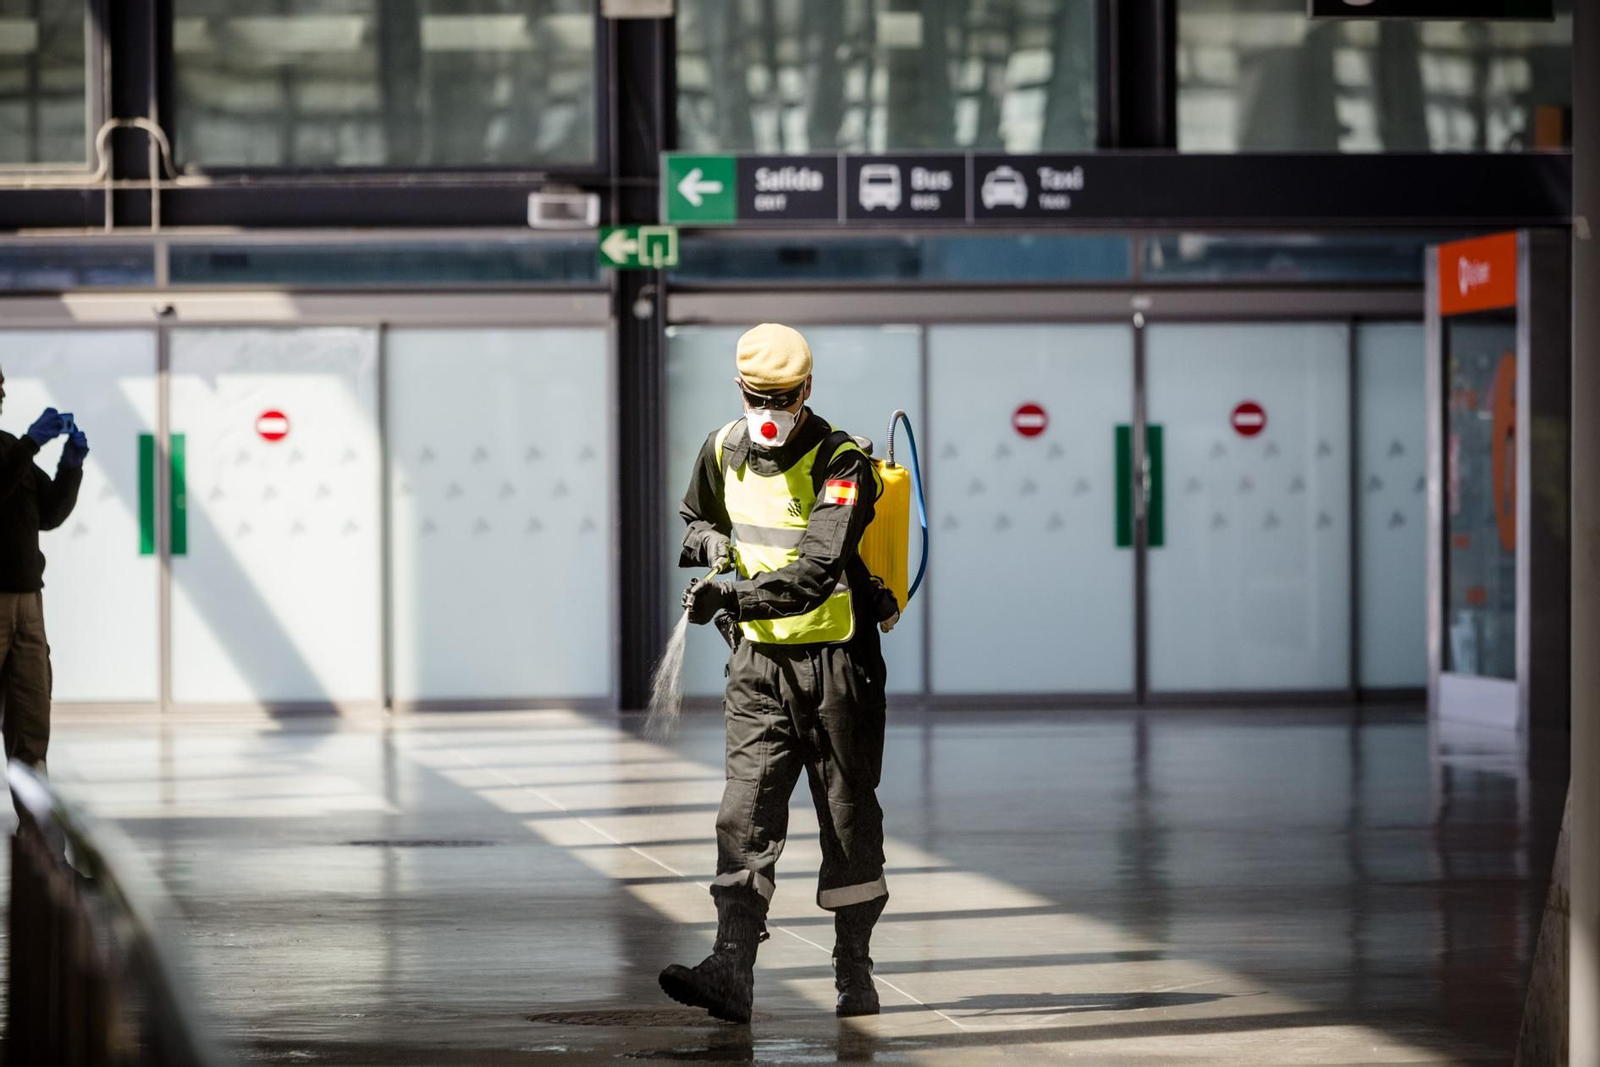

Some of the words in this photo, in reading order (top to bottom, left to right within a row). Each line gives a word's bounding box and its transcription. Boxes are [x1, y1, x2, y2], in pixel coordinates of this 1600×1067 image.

[755, 167, 823, 191] Salida
[911, 167, 952, 190] Bus
[1039, 167, 1083, 190] Taxi
